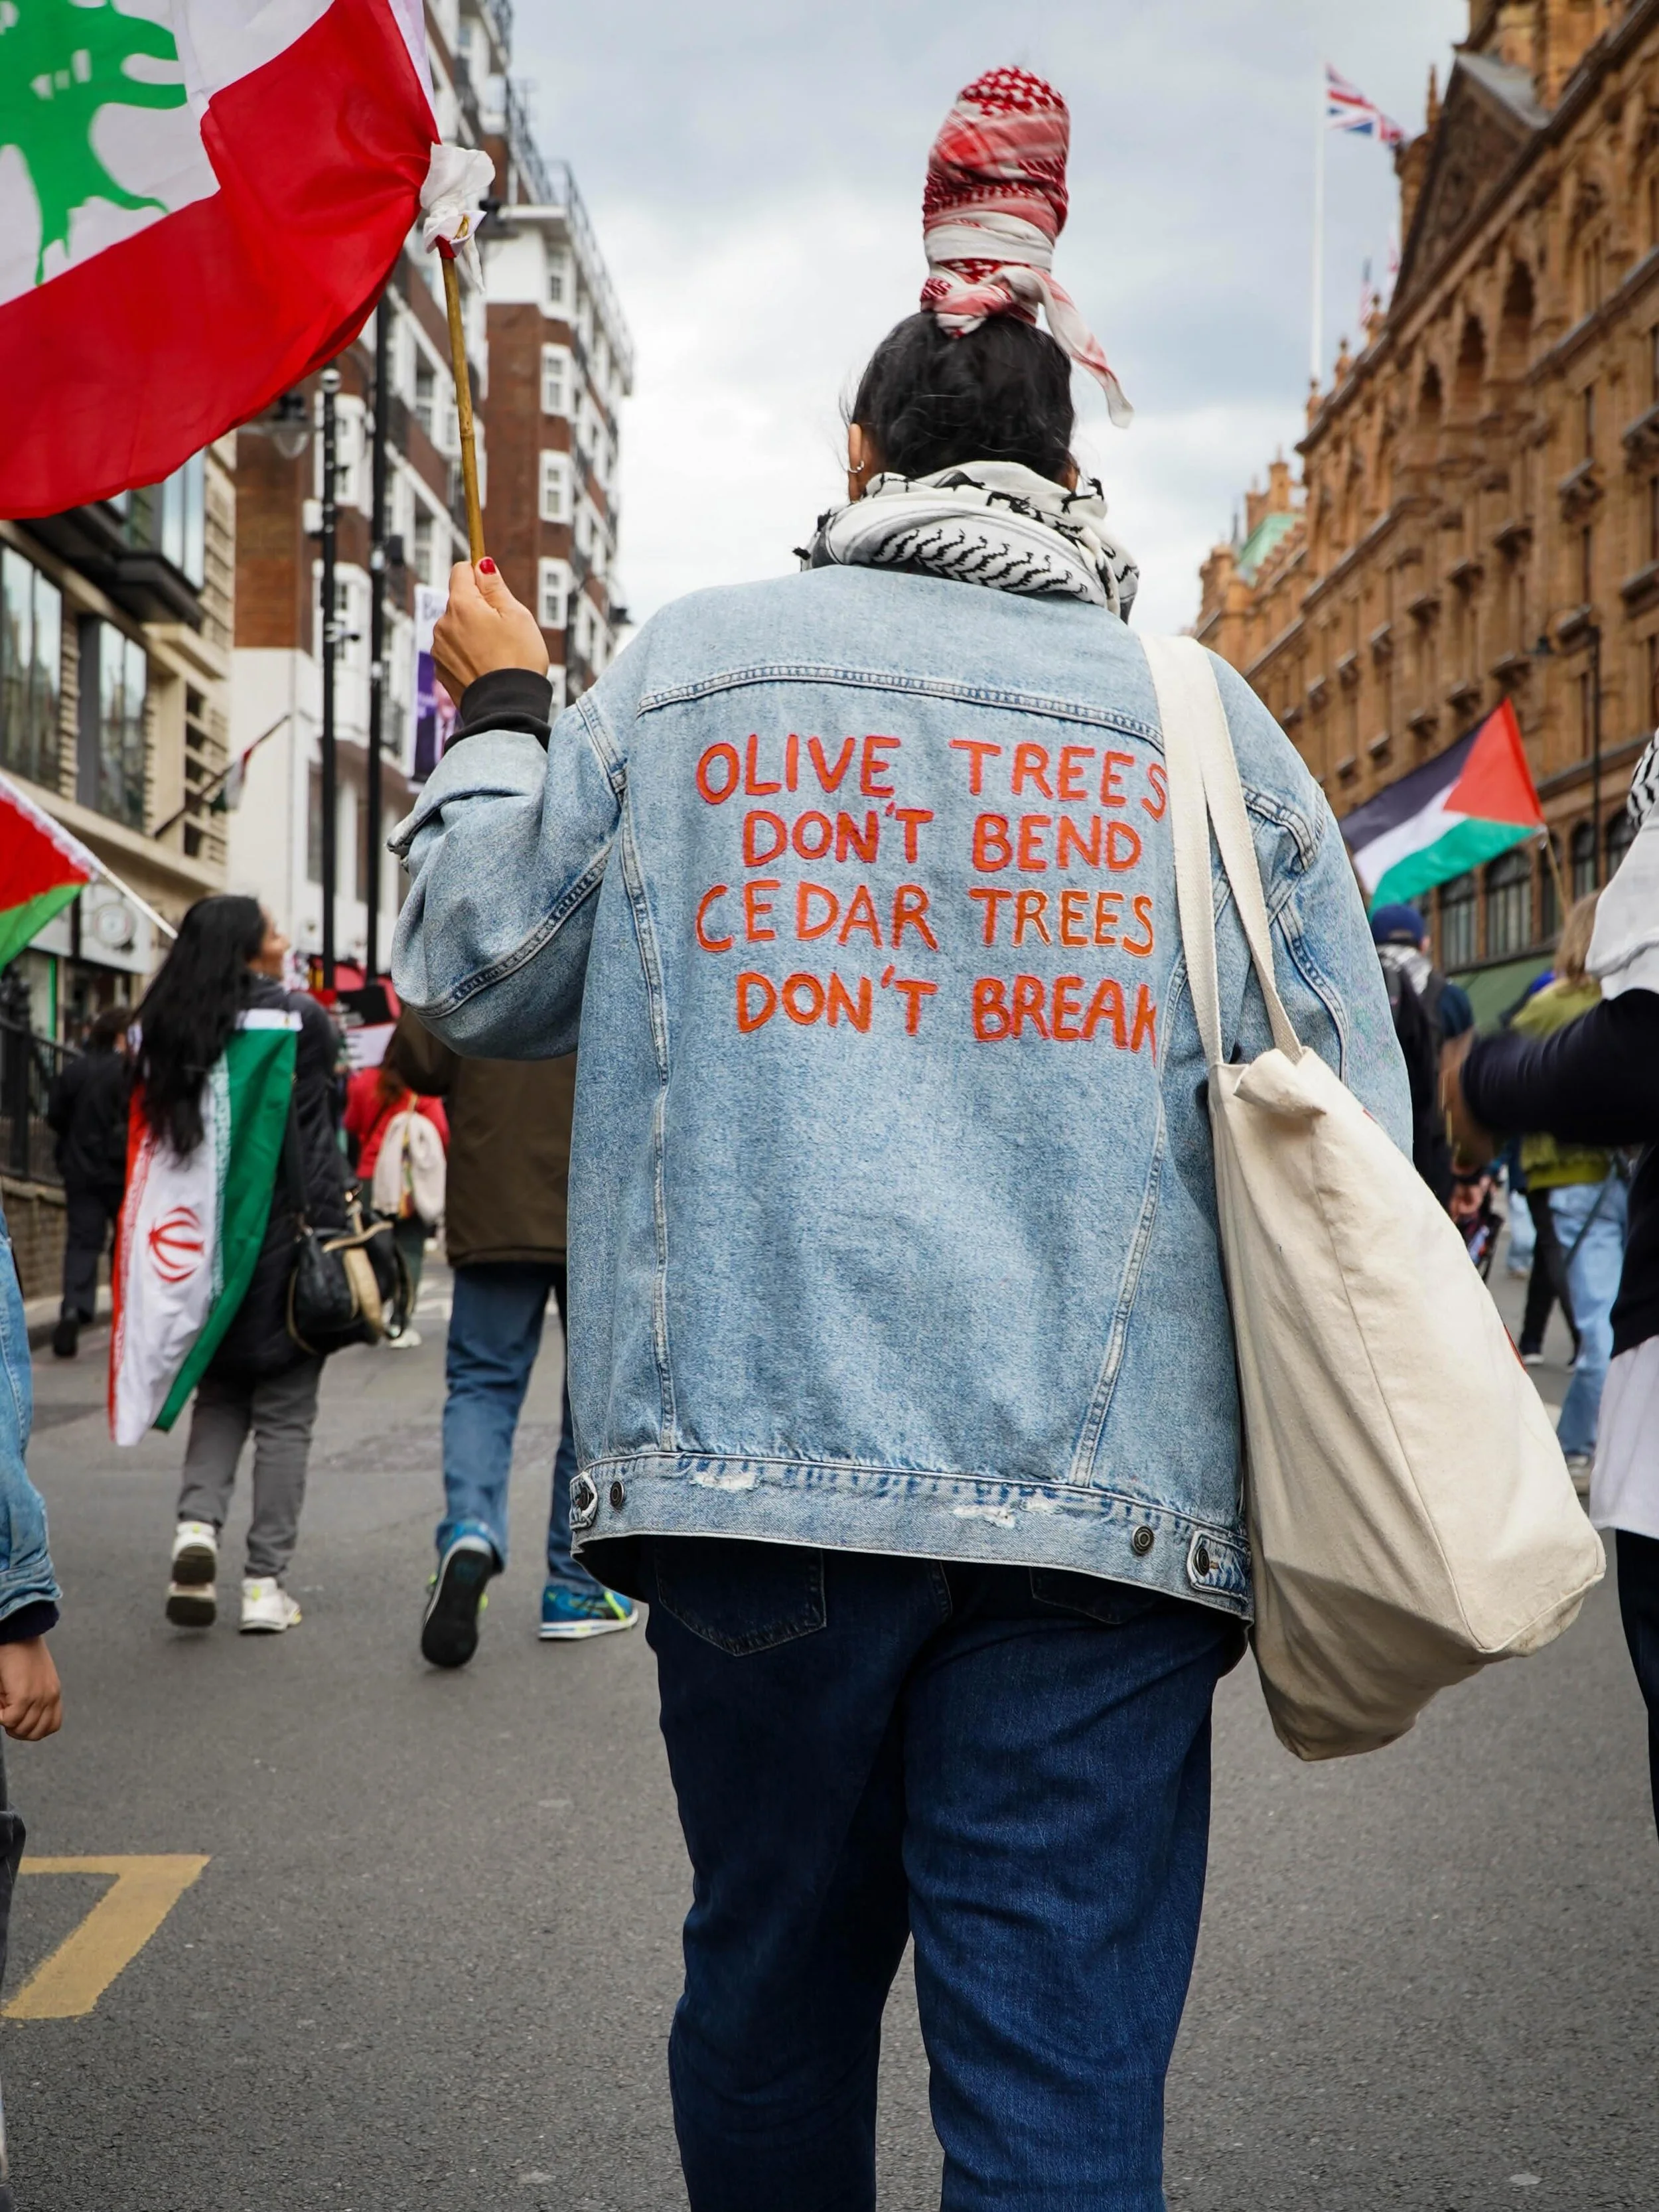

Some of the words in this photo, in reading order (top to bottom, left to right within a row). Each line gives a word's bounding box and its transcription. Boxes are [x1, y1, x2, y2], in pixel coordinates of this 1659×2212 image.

[696, 734, 901, 804] OLIVE
[950, 739, 1167, 822] TREES
[743, 801, 934, 867] DON'T
[972, 813, 1141, 873] BEND
[696, 879, 938, 952] CEDAR
[968, 888, 1153, 958] TREES
[737, 965, 938, 1037] DON'T
[972, 975, 1157, 1067] BREAK
